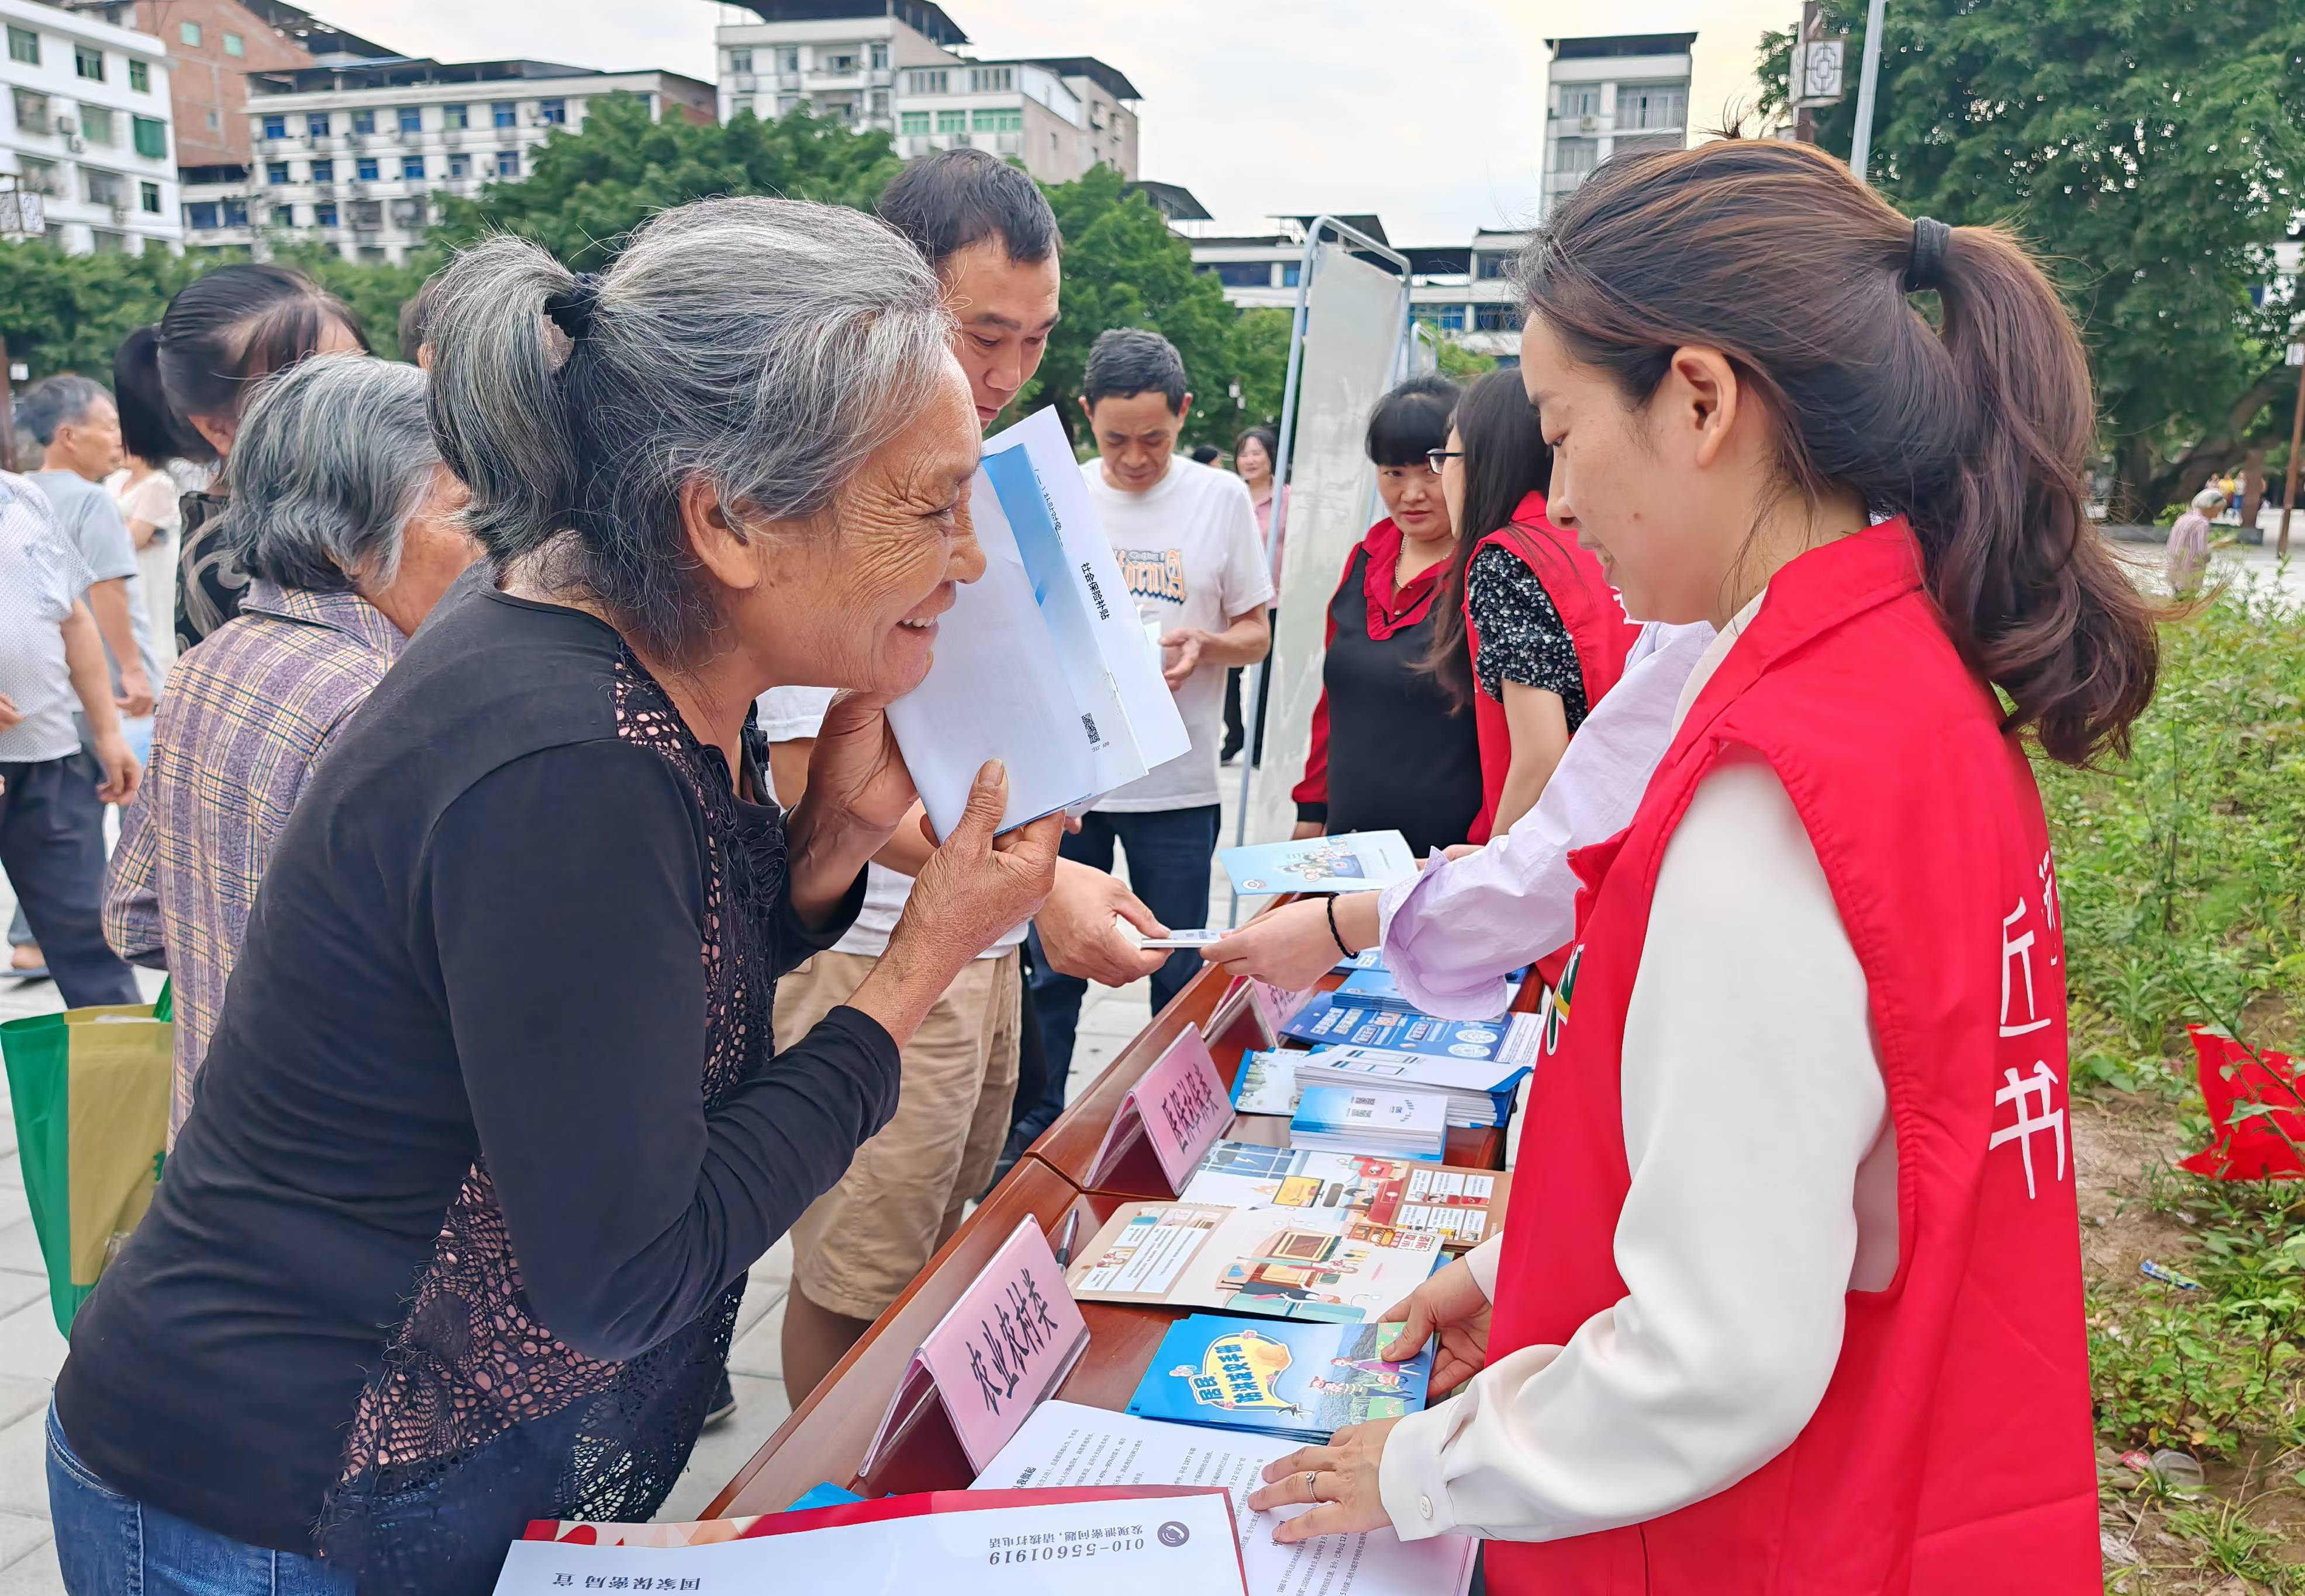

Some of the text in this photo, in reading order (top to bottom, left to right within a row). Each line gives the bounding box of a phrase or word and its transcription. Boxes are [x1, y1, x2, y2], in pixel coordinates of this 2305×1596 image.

[1081, 562, 1110, 620] 社会保险补贴
[965, 1267, 1058, 1416] 农业农村类
[1193, 1376, 1224, 1401] 居民
[989, 1524, 1143, 1549] 发现泄密问题,请拨打电话
[989, 1538, 1144, 1566] 010-55601919
[551, 1572, 701, 1591] 国家保密局 宣
